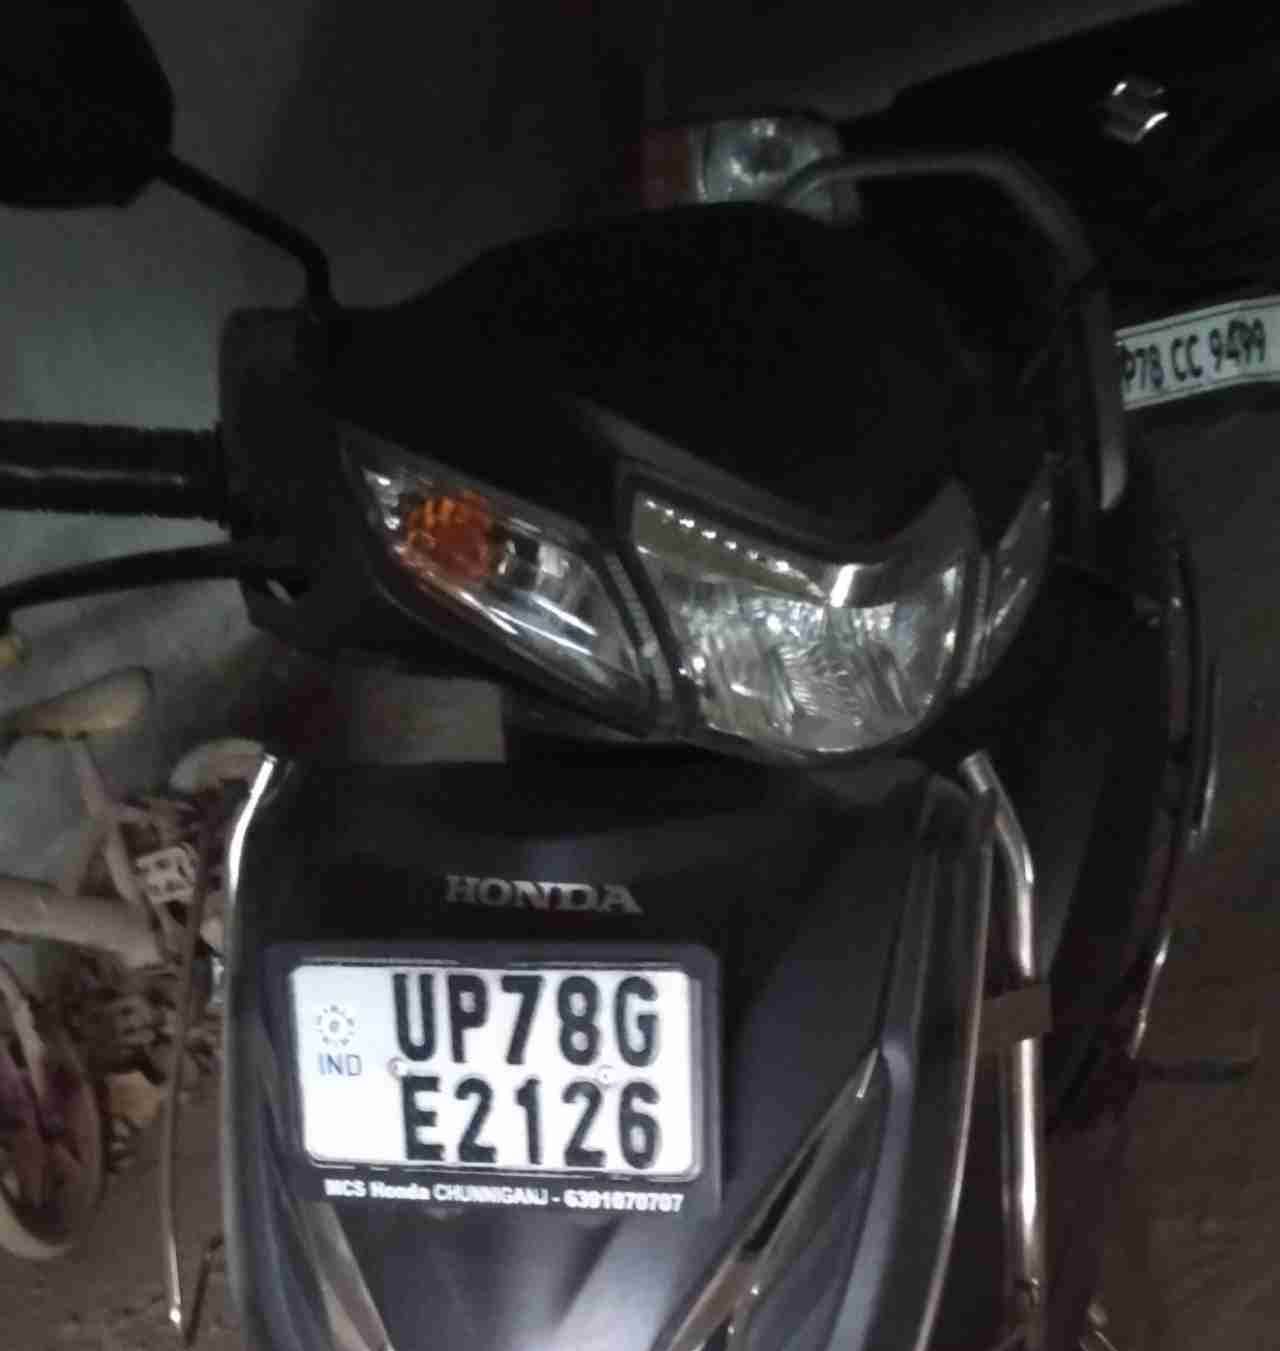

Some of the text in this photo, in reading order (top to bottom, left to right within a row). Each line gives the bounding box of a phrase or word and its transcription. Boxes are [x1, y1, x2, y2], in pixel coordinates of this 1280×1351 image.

[1171, 334, 1203, 382] CC
[445, 875, 642, 914] HONDA
[393, 972, 658, 1067] UP78G
[318, 1053, 362, 1077] IND
[402, 1075, 660, 1170] E2126
[369, 1180, 431, 1201] Honda
